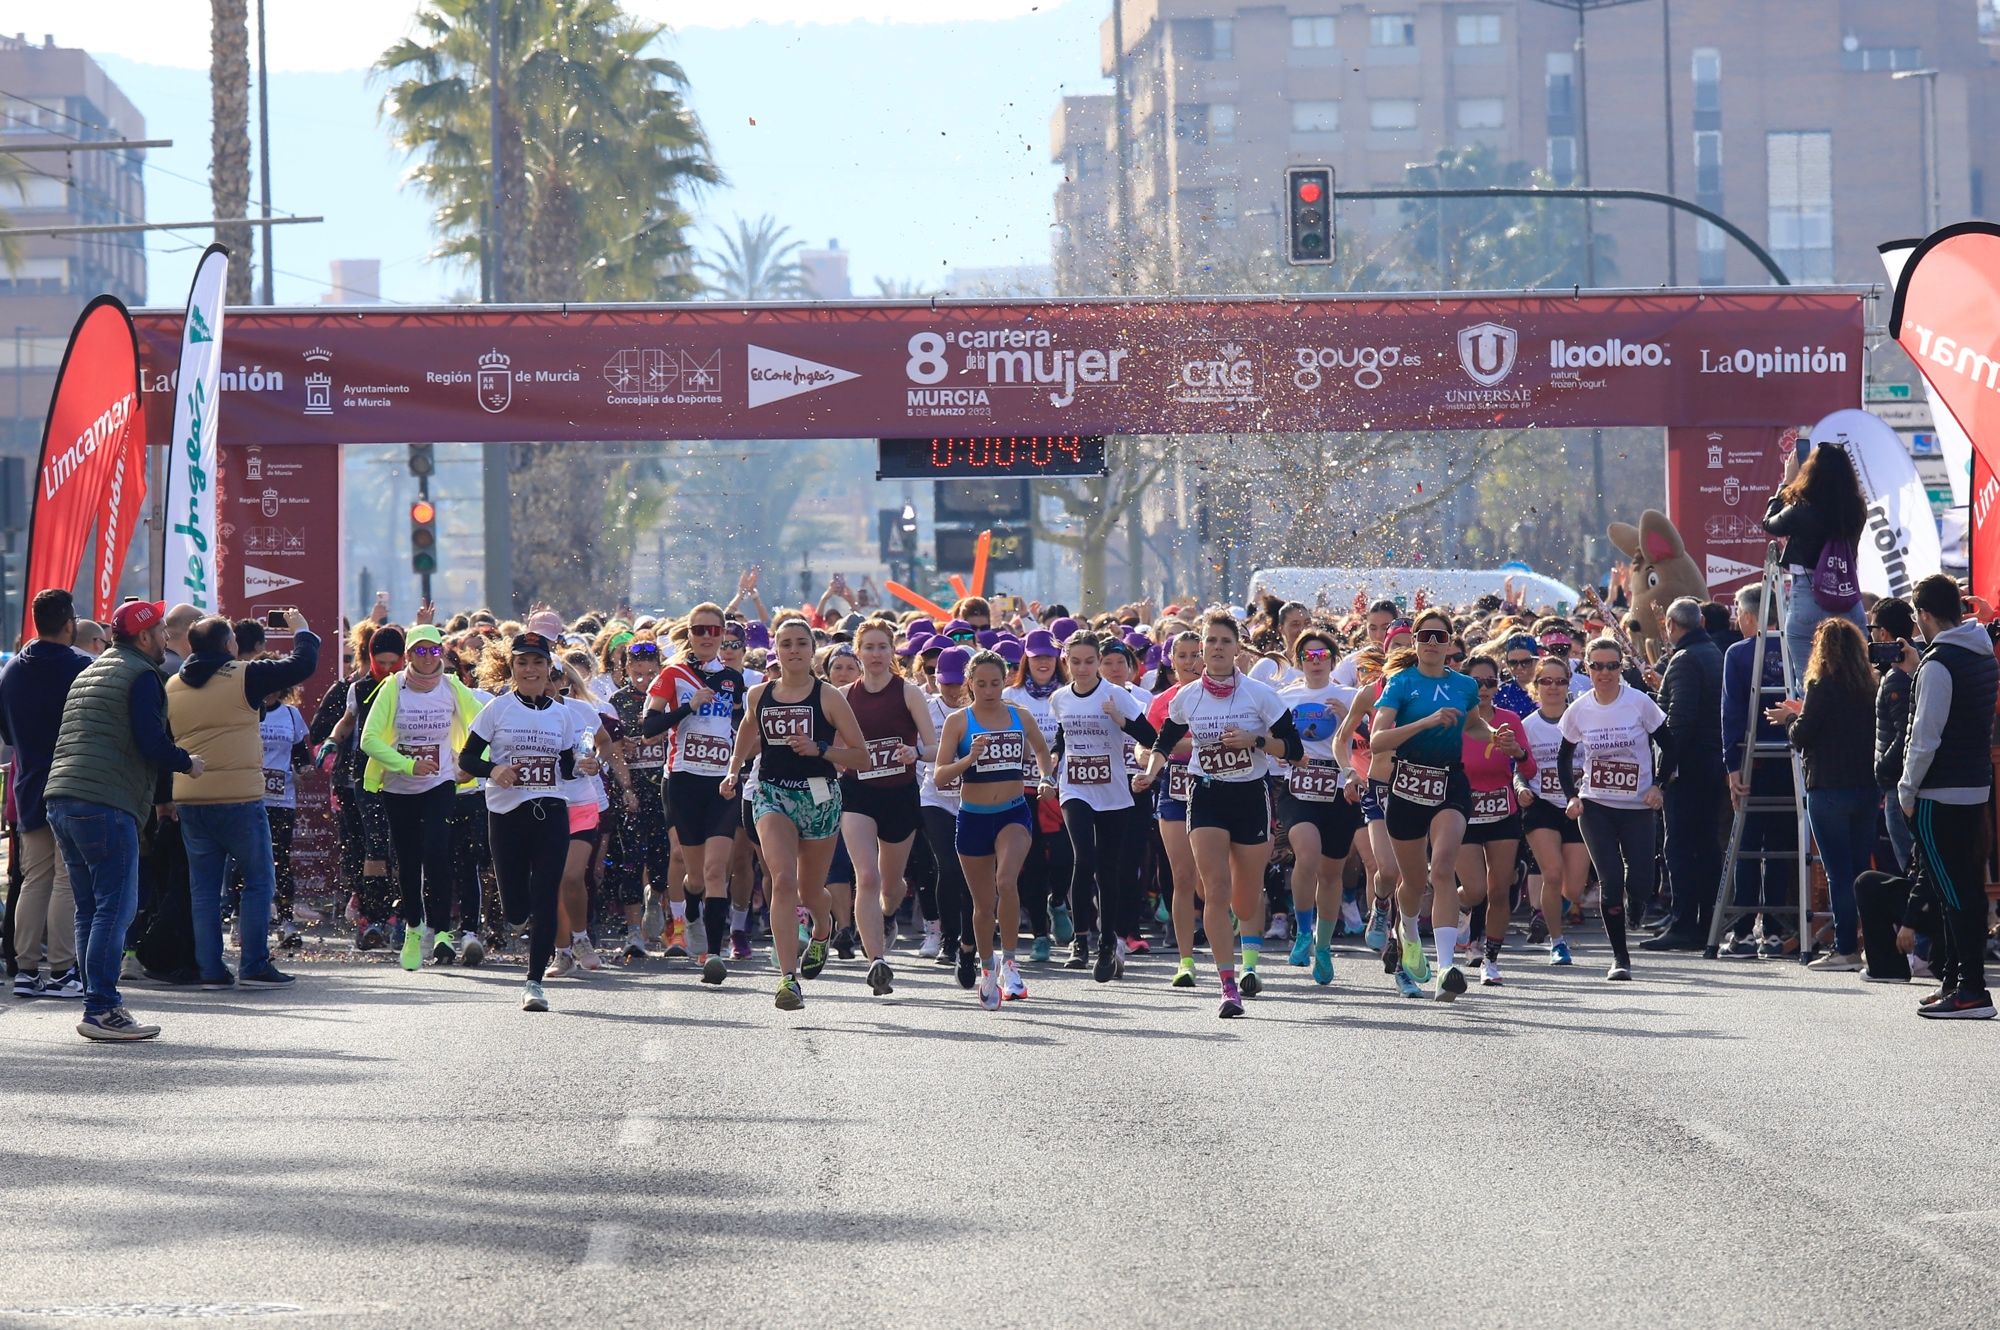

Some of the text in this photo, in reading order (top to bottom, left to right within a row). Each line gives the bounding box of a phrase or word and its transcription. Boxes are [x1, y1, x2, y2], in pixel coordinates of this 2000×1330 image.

[958, 328, 1050, 349] carrera
[1700, 346, 1847, 378] LaOpinión
[140, 365, 283, 392] Lanión
[426, 369, 580, 386] Región de Murcia
[764, 369, 792, 382] Corte
[793, 365, 835, 387] Inglés
[986, 348, 1128, 408] mujer
[1182, 359, 1252, 387] CRC
[1551, 371, 1579, 380] natural
[343, 384, 410, 395] Ayuntamiento
[1551, 379, 1577, 389] frozen
[343, 397, 392, 408] de Murcia
[661, 395, 675, 405] de
[676, 394, 723, 406] Deportes
[907, 389, 990, 406] MURCIA
[1446, 389, 1532, 402] UNIVERSAE
[907, 407, 991, 417] 5 DE MARZO 2023
[1477, 402, 1509, 411] Superior
[1510, 402, 1520, 410] de
[1521, 401, 1531, 410] FP
[43, 392, 132, 501] Limcamar
[239, 496, 310, 504] Región de Murcia
[184, 555, 207, 610] rte
[764, 718, 809, 735] 1611
[685, 743, 730, 762] 3840
[978, 743, 1021, 761] 2888
[1200, 749, 1250, 770] 2104
[519, 766, 551, 782] 315
[1068, 765, 1110, 781] 1803
[267, 778, 284, 792] 65
[779, 779, 811, 789] NIKE
[1292, 775, 1336, 793] 1812
[1396, 773, 1444, 796] 3218
[1474, 797, 1508, 814] 482
